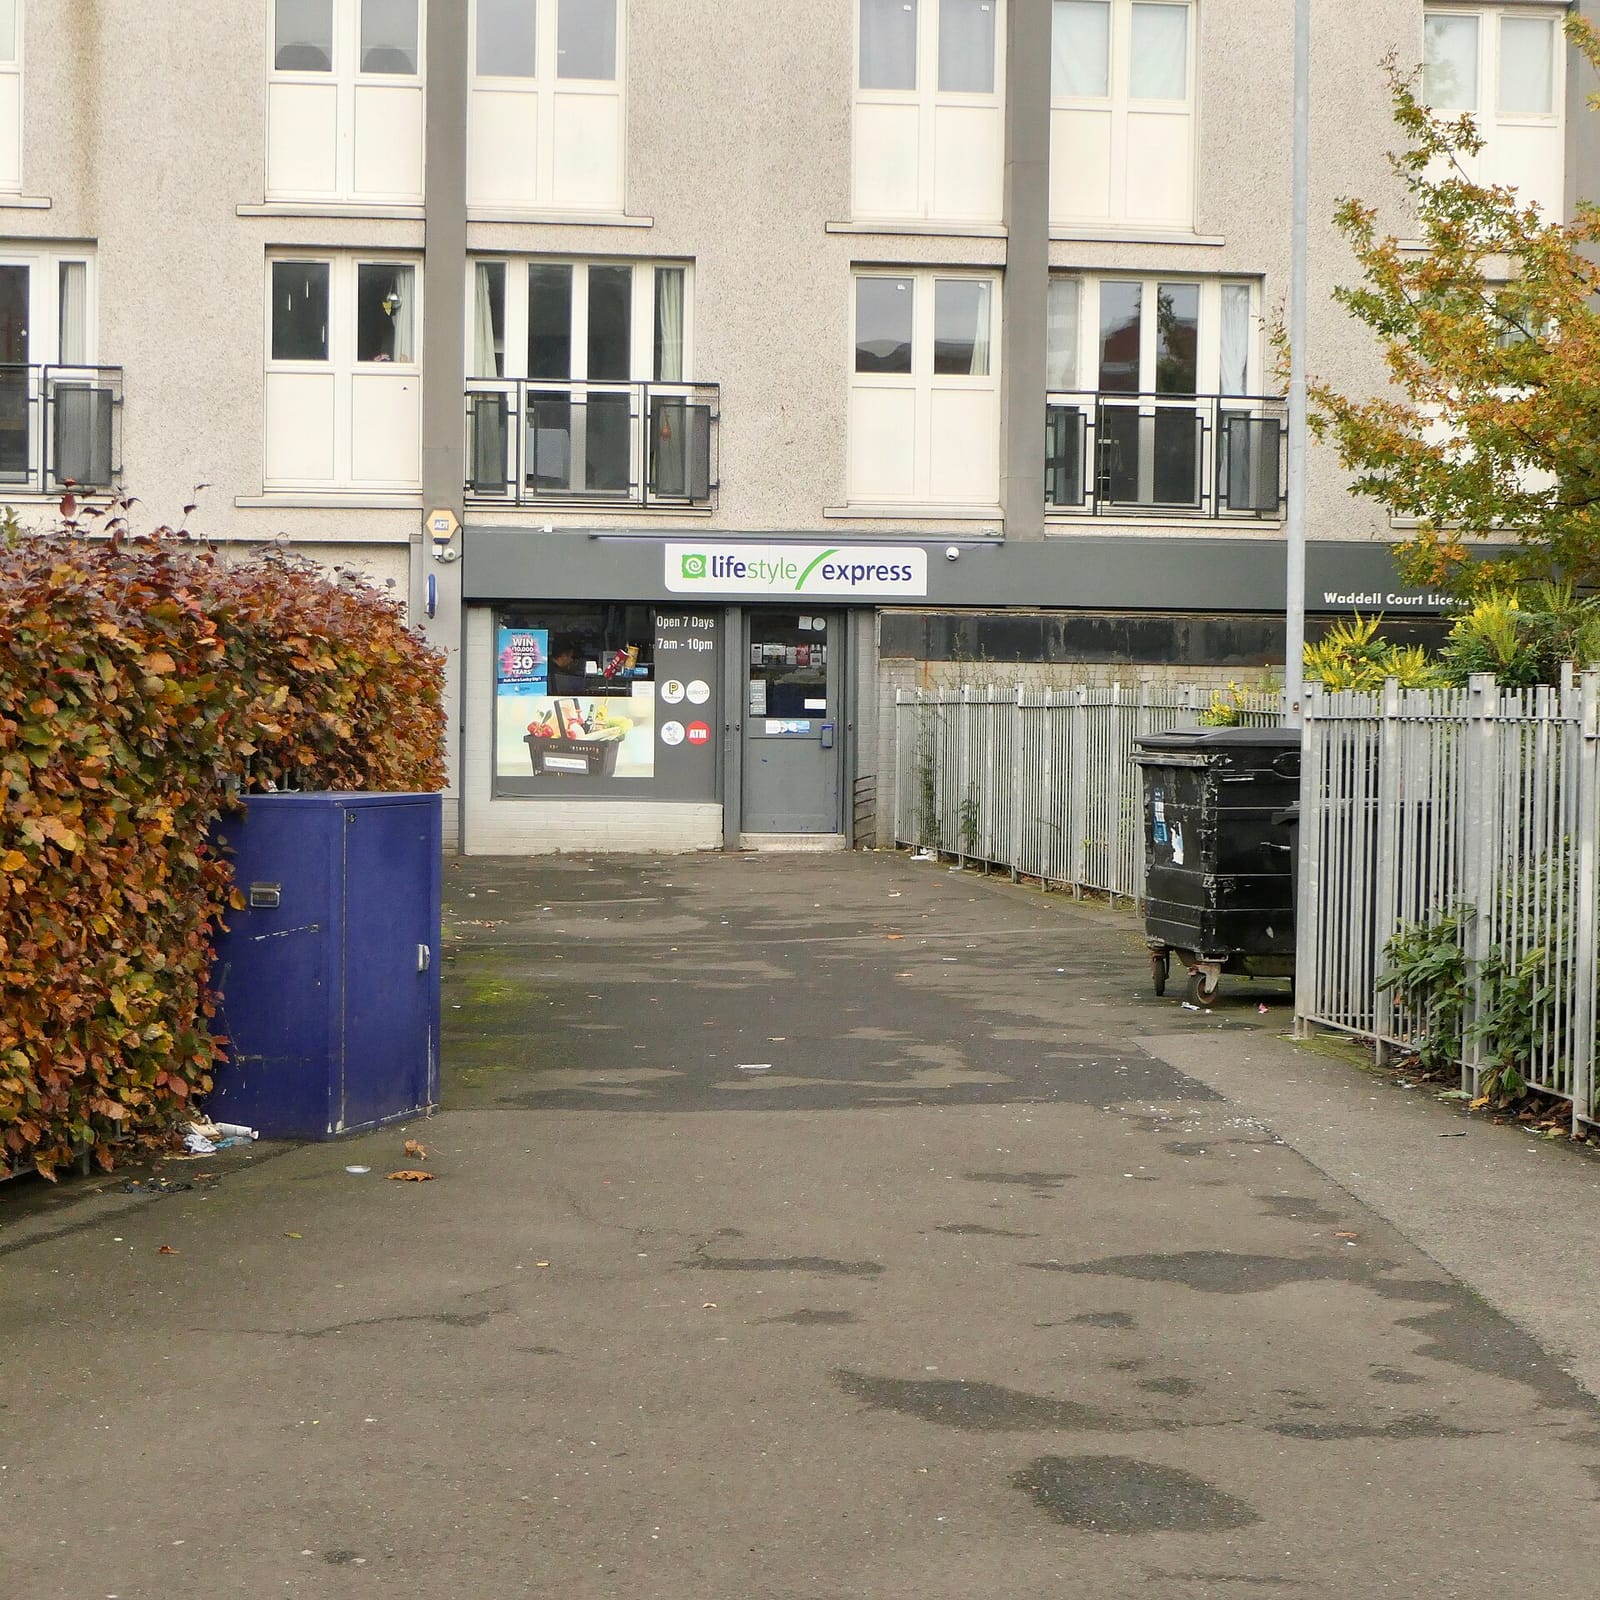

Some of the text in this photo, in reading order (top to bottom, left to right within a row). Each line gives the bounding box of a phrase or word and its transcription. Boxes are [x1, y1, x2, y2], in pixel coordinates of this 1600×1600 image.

[711, 555, 912, 586] lifestyle express
[1324, 592, 1381, 605] Waddell
[1386, 593, 1424, 606] Court
[656, 615, 715, 630] Open 7 Days
[512, 637, 534, 647] WIN
[657, 637, 678, 650] 7am
[687, 638, 713, 653] 10pm
[512, 656, 533, 669] 30
[689, 728, 707, 739] ATM
